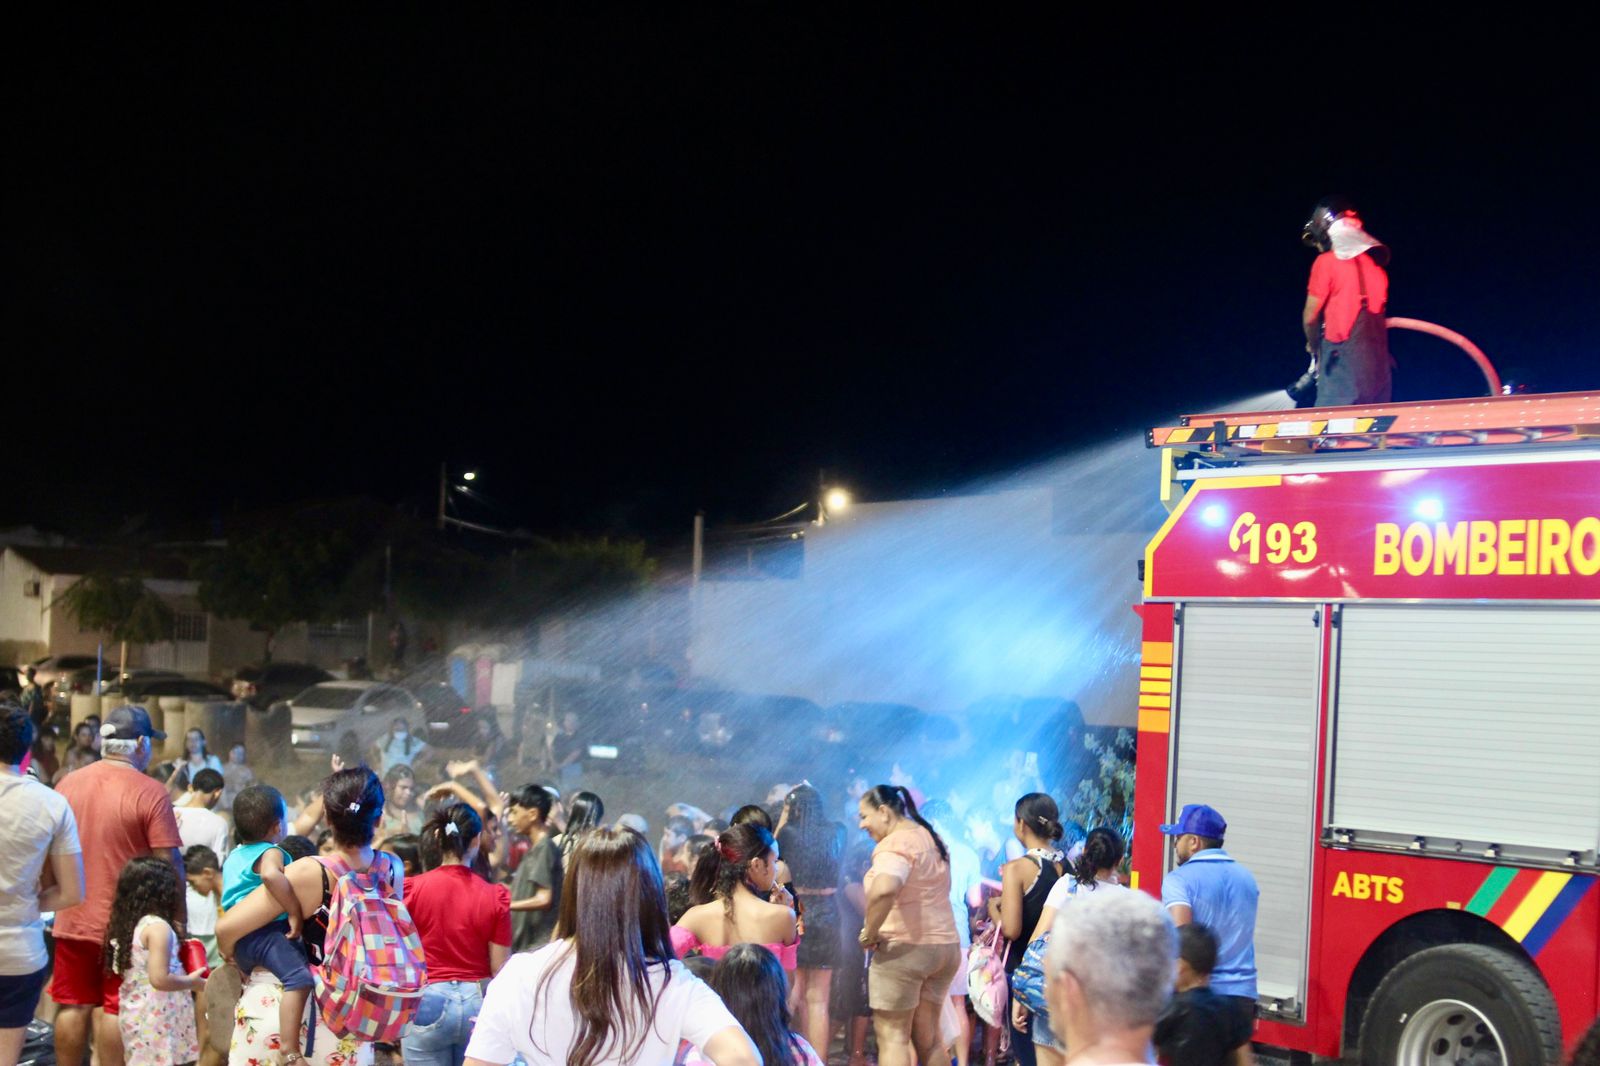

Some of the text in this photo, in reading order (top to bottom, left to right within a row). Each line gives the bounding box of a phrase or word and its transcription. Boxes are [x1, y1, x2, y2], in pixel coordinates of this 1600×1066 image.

[1242, 521, 1317, 564] 193
[1374, 516, 1600, 576] BOMBEIRO
[1331, 871, 1404, 904] ABTS
